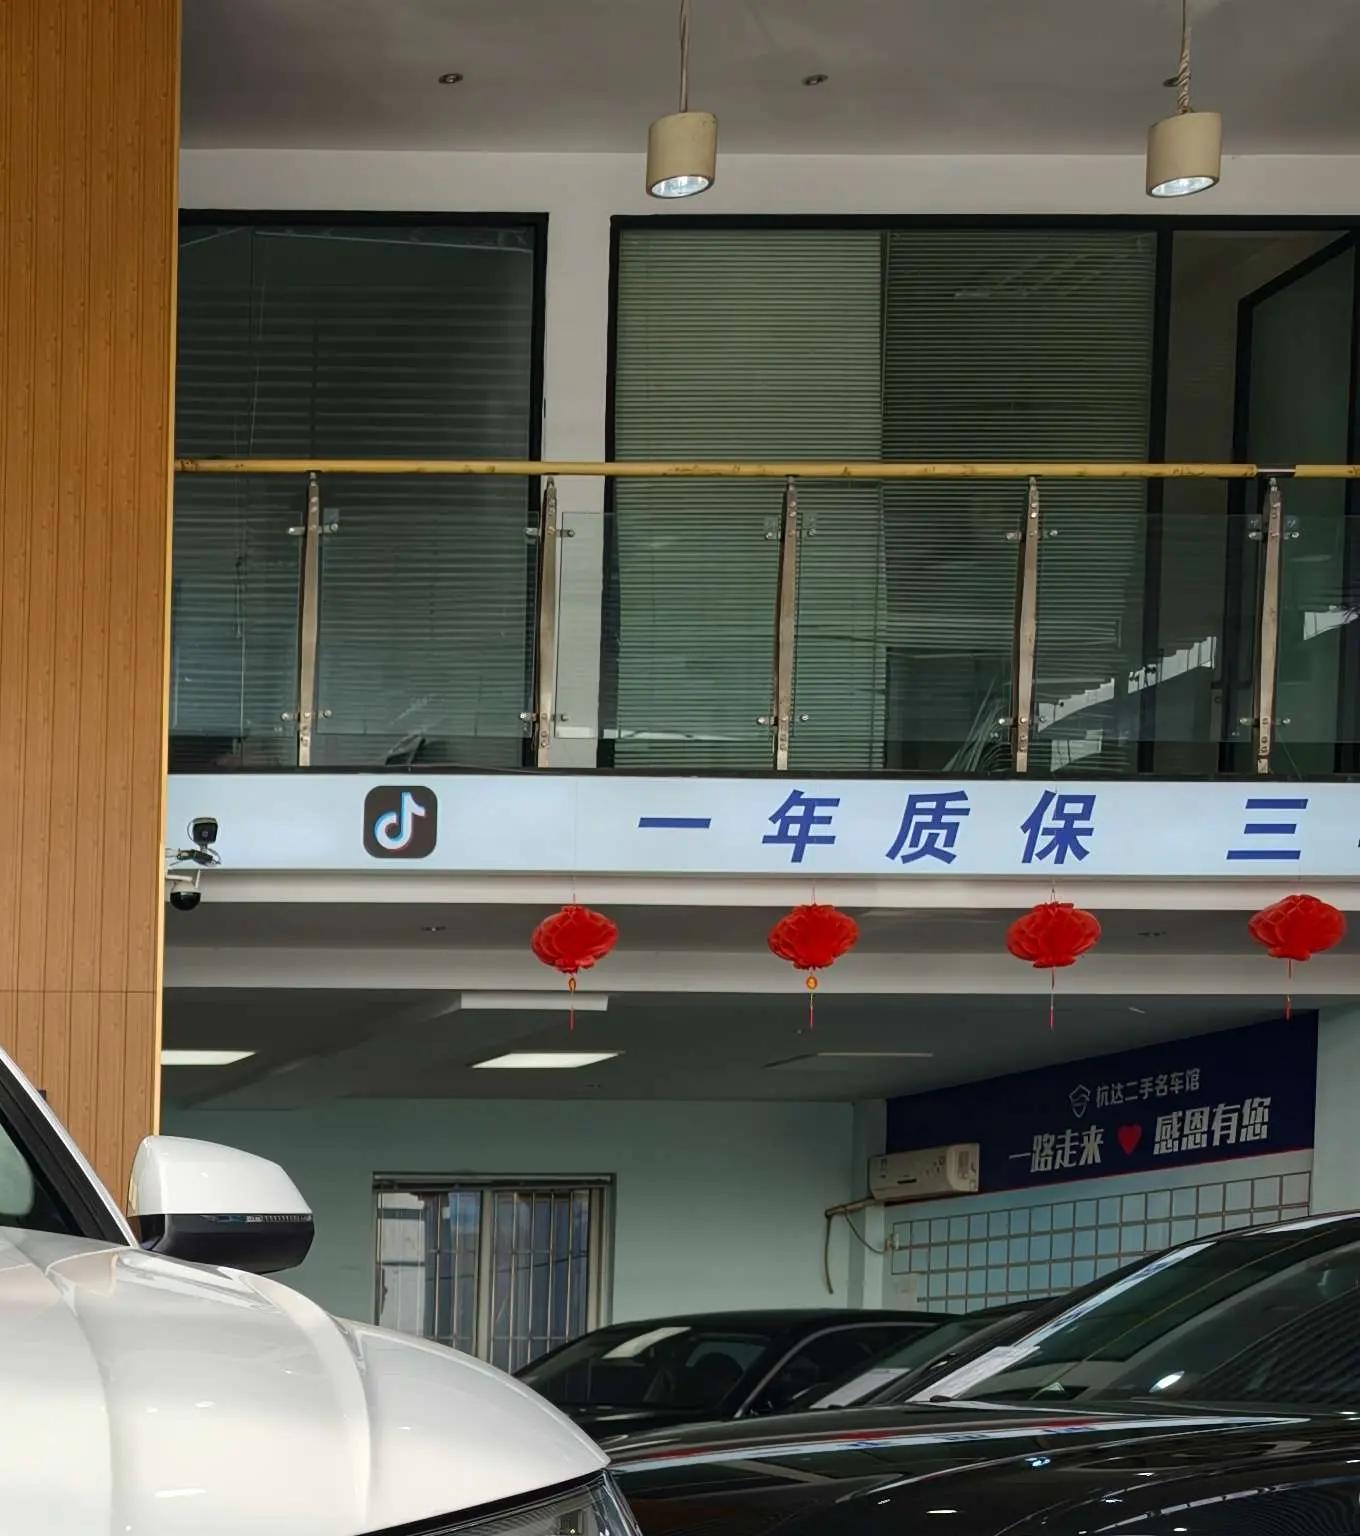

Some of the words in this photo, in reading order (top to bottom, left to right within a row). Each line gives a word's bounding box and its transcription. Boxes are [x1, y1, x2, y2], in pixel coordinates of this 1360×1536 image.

[638, 790, 1097, 865] 一年质保
[1095, 1067, 1201, 1109] 杭达二手名车馆
[1008, 1124, 1105, 1174] 一路走来
[1152, 1096, 1272, 1156] 感恩有您
